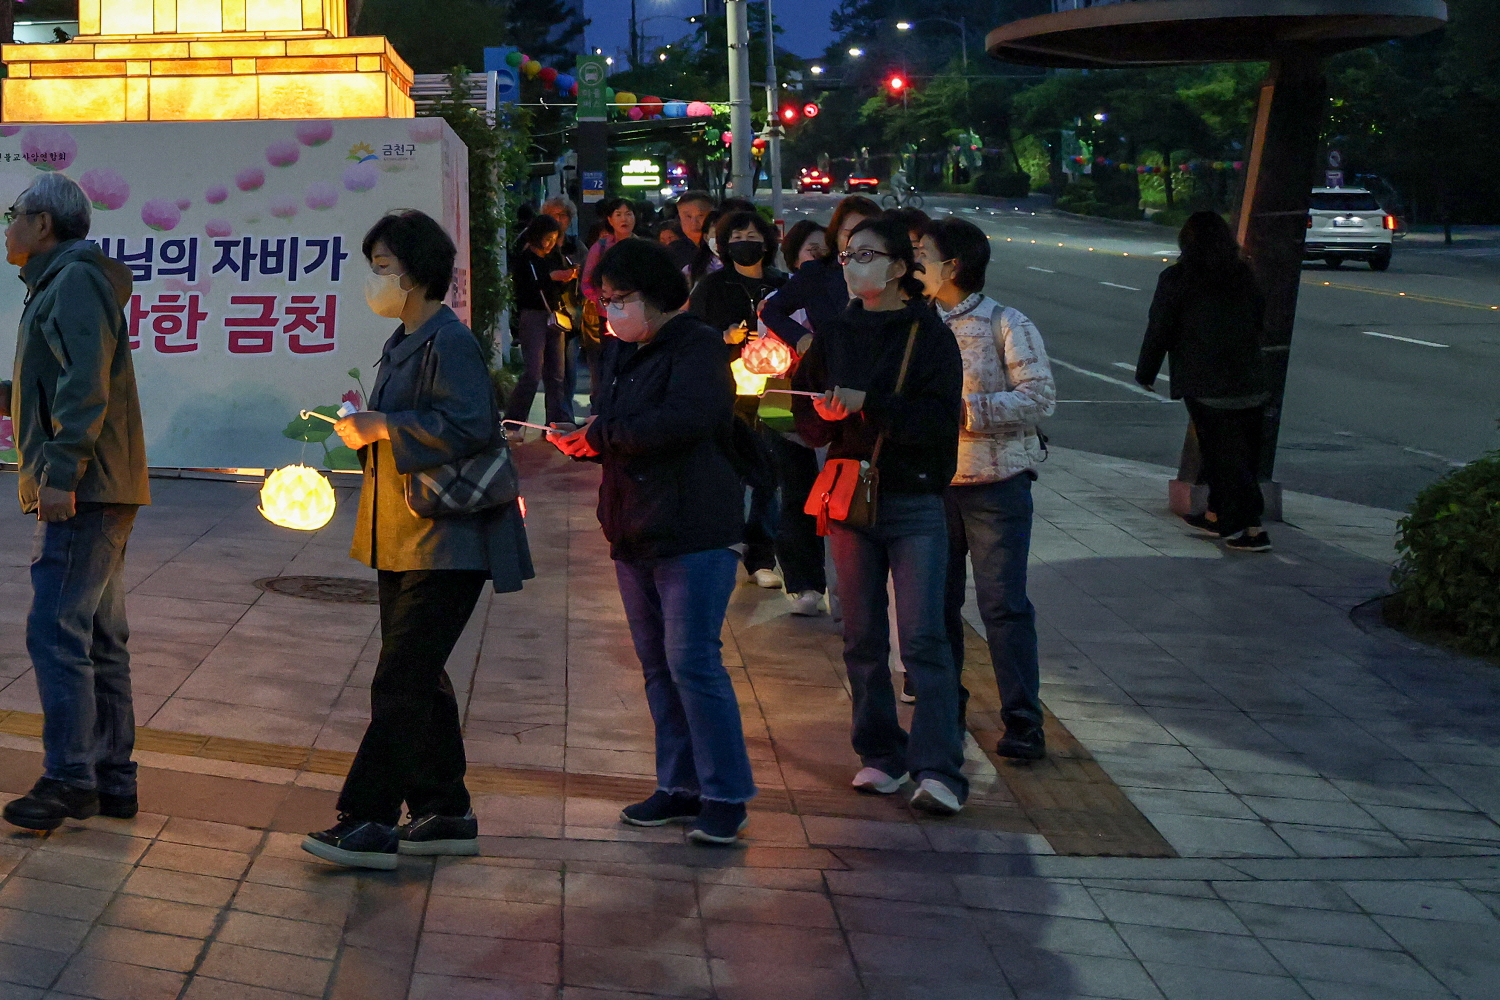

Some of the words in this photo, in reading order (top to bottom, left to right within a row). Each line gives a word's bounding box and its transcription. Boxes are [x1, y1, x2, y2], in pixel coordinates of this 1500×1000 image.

[381, 143, 417, 157] 금천구
[593, 179, 604, 189] 72
[86, 237, 198, 282] 님의
[212, 236, 349, 282] 자비가
[224, 294, 337, 354] 금천
